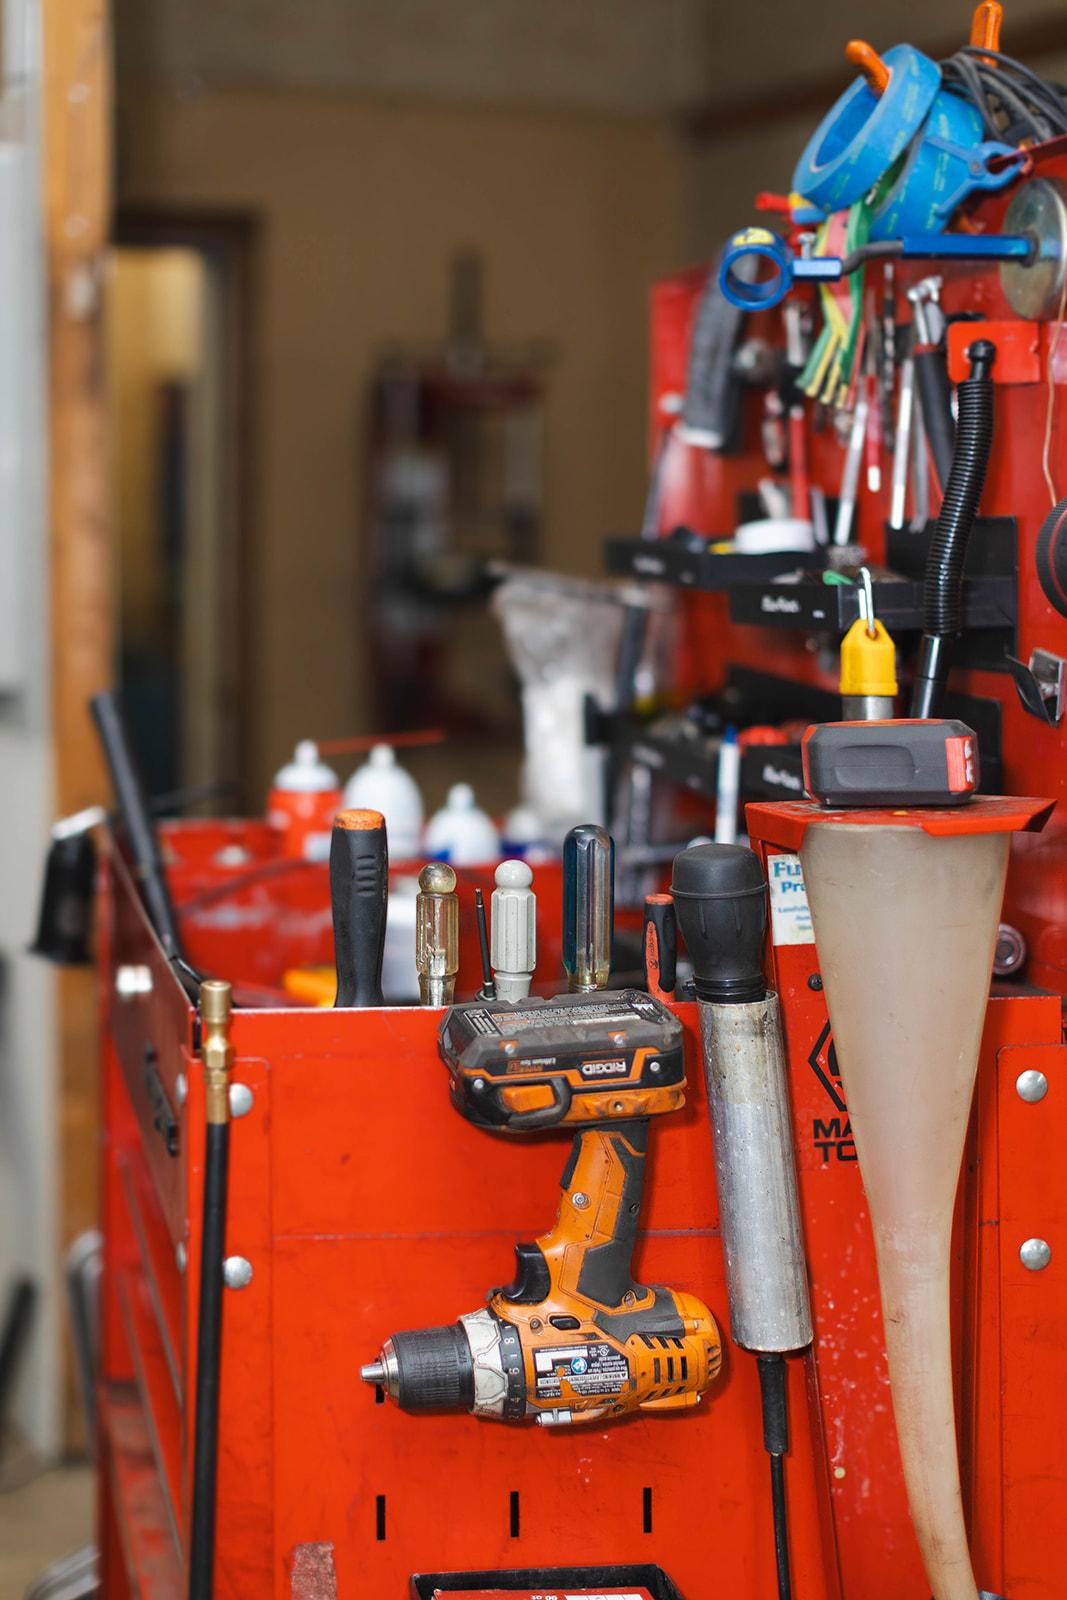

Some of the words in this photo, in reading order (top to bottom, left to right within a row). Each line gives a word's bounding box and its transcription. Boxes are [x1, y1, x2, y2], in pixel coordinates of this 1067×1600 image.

[583, 1061, 626, 1075] RIDGID
[504, 1337, 515, 1345] 8
[508, 1367, 520, 1375] 6
